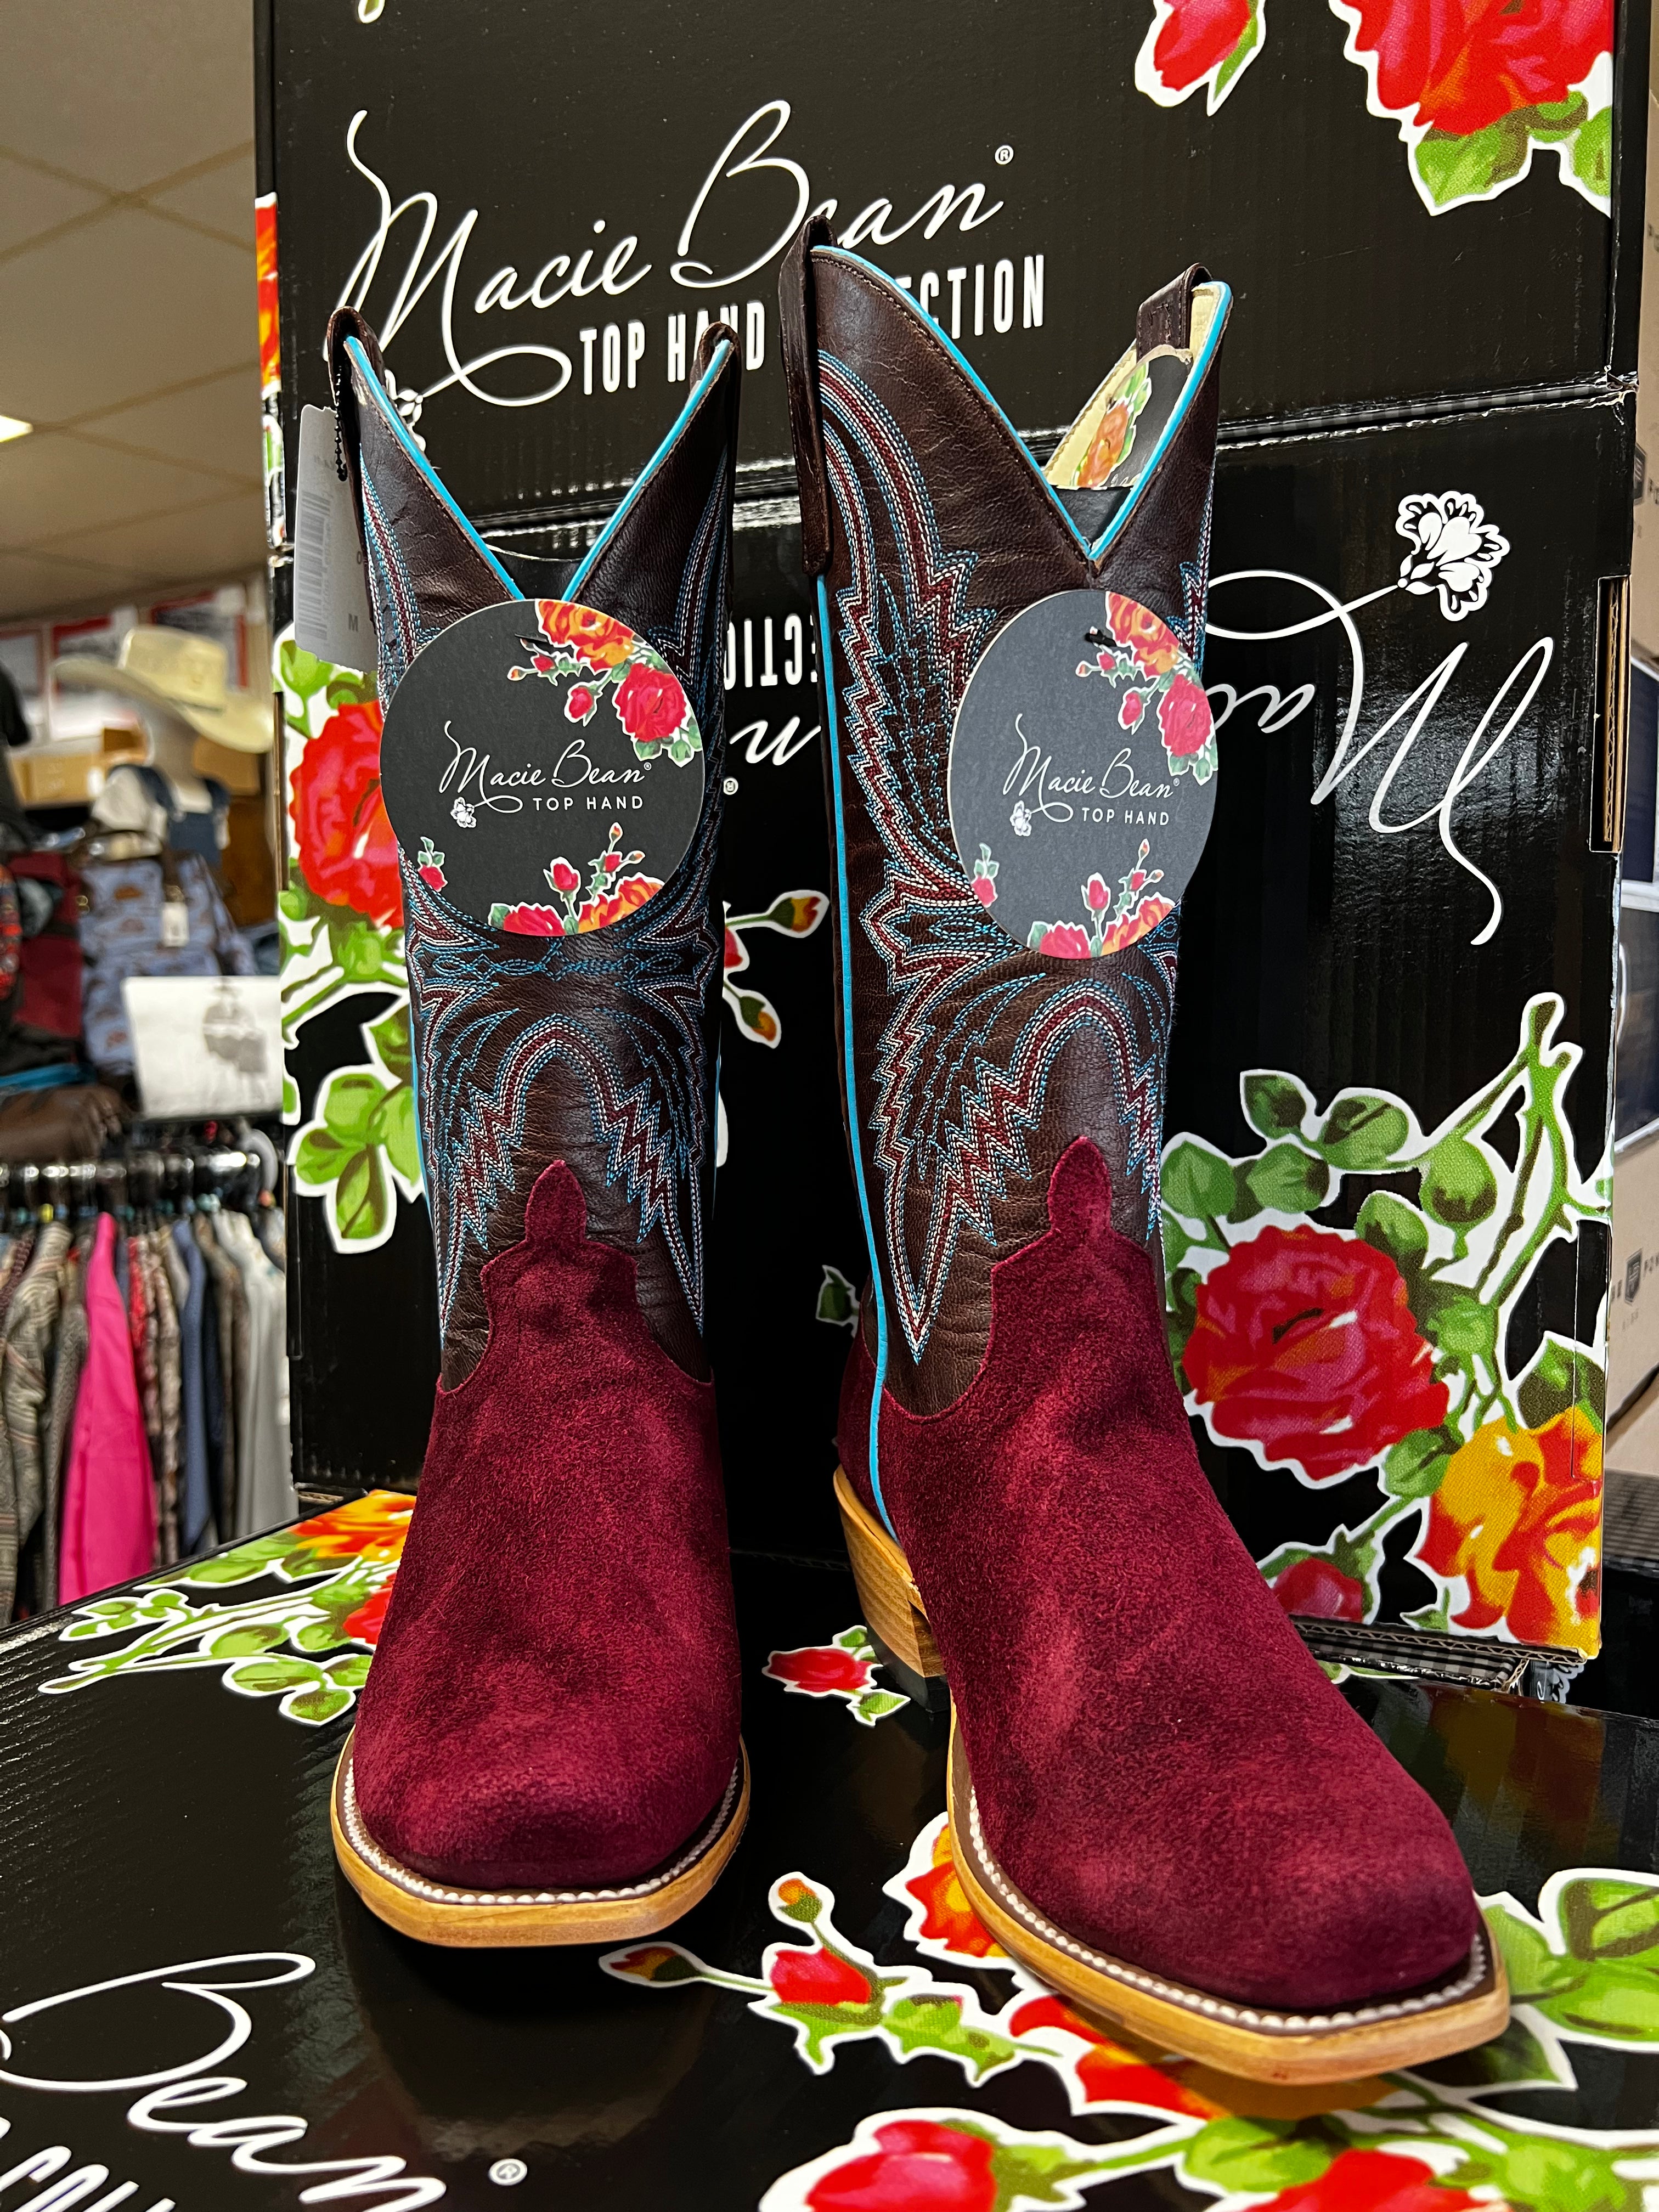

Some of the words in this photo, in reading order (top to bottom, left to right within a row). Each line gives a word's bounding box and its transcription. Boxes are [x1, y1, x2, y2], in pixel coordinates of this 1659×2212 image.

[323, 110, 652, 407] Macie
[579, 321, 645, 395] TOP
[439, 720, 546, 814] Macie
[533, 797, 573, 811] TOP
[586, 795, 644, 810] HAND
[1002, 713, 1096, 822] Macie
[1081, 807, 1115, 823] TOP
[1125, 810, 1169, 826] HAND
